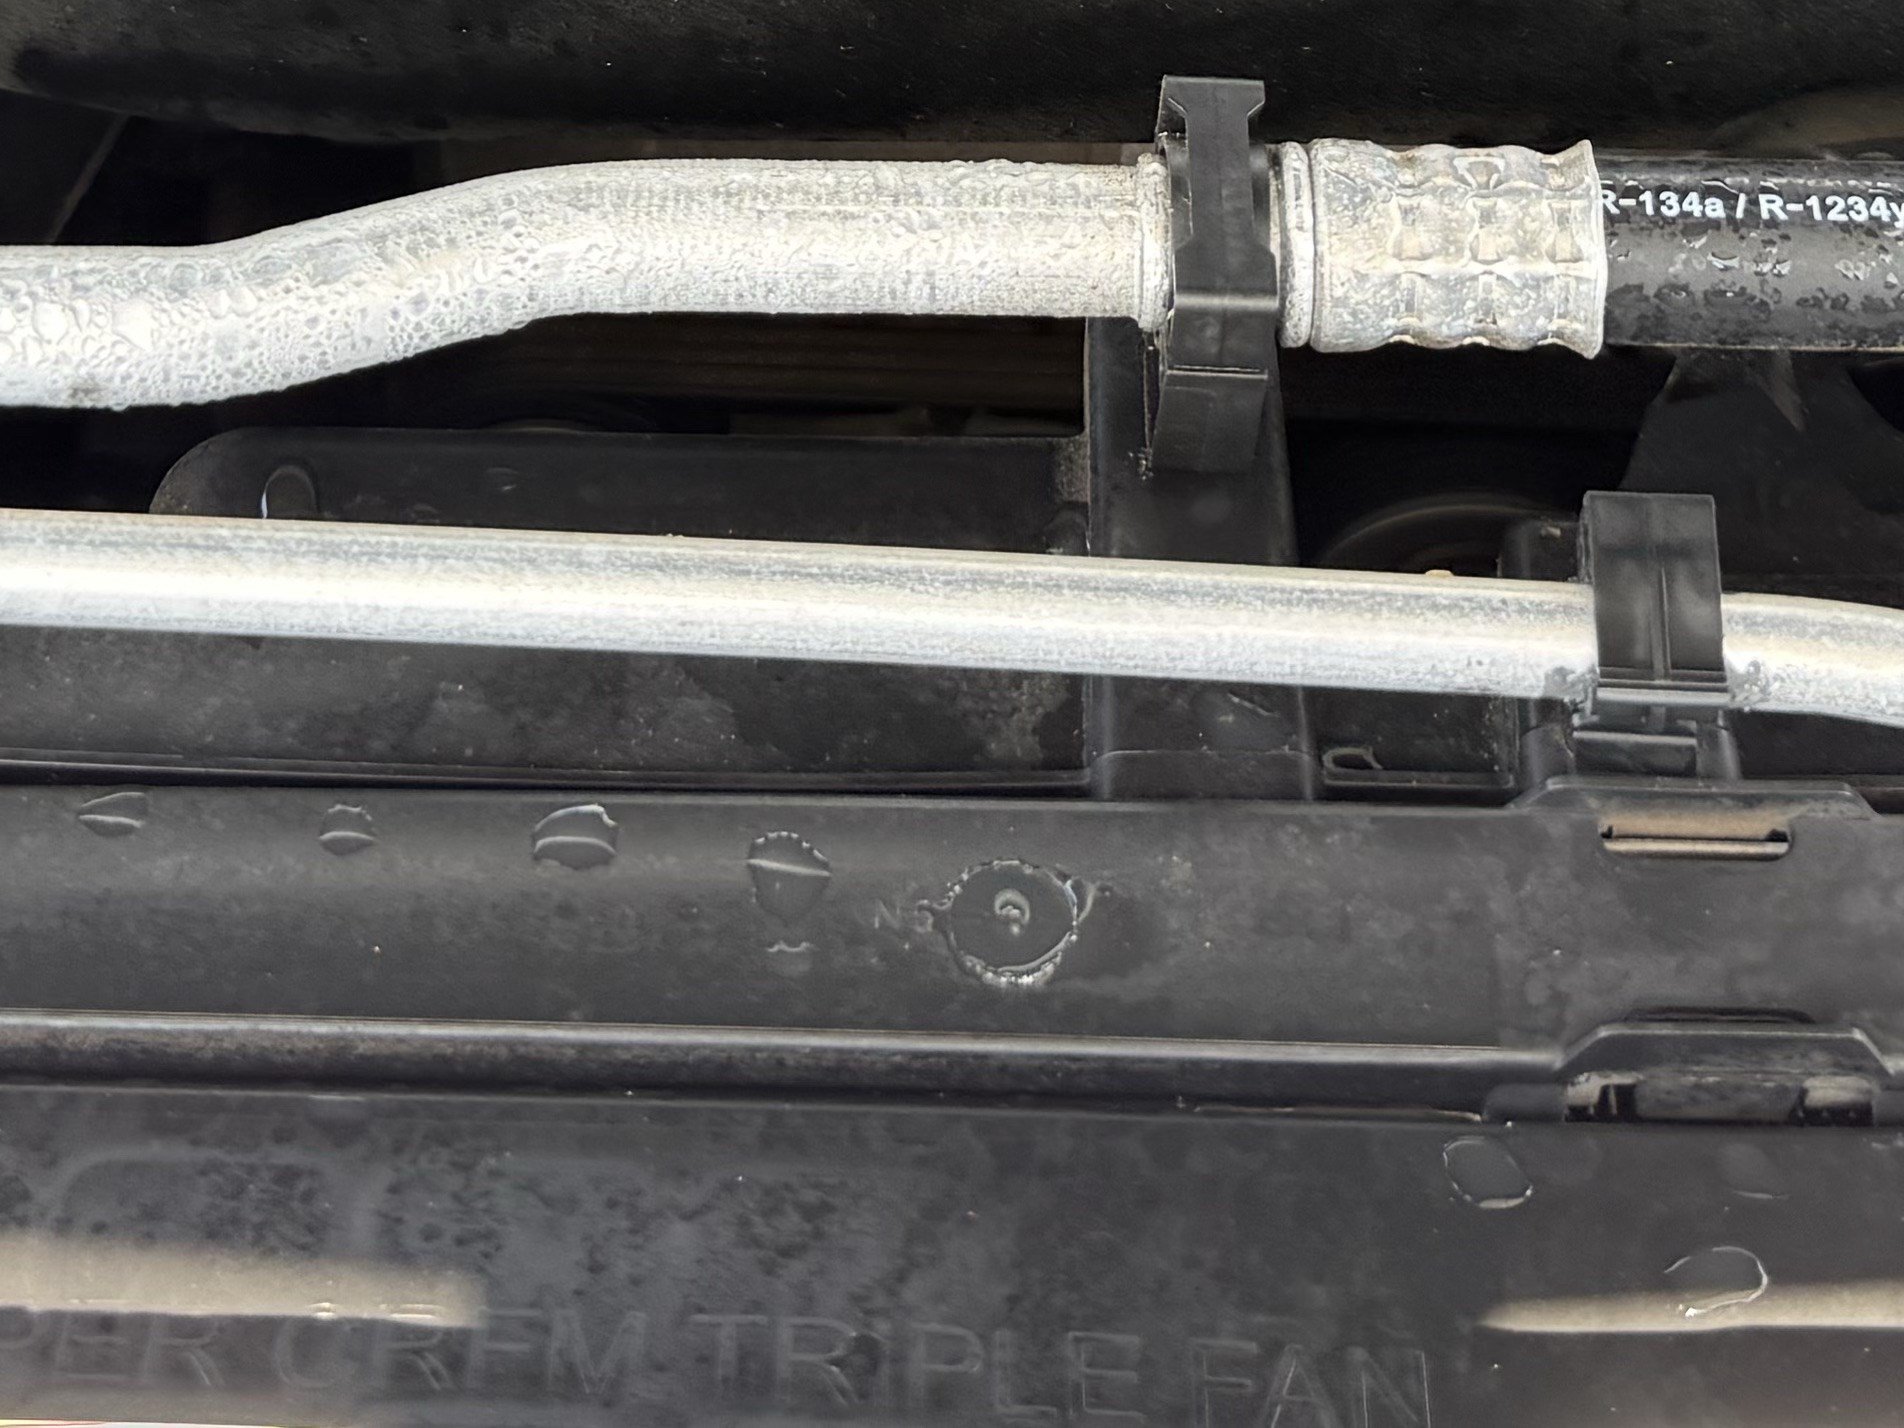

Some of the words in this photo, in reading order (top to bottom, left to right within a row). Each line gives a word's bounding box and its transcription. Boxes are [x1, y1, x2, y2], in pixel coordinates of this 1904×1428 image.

[1601, 189, 1726, 218] R-134a
[691, 1311, 1146, 1425] TRIPLE
[1192, 1334, 1433, 1428] FAN
